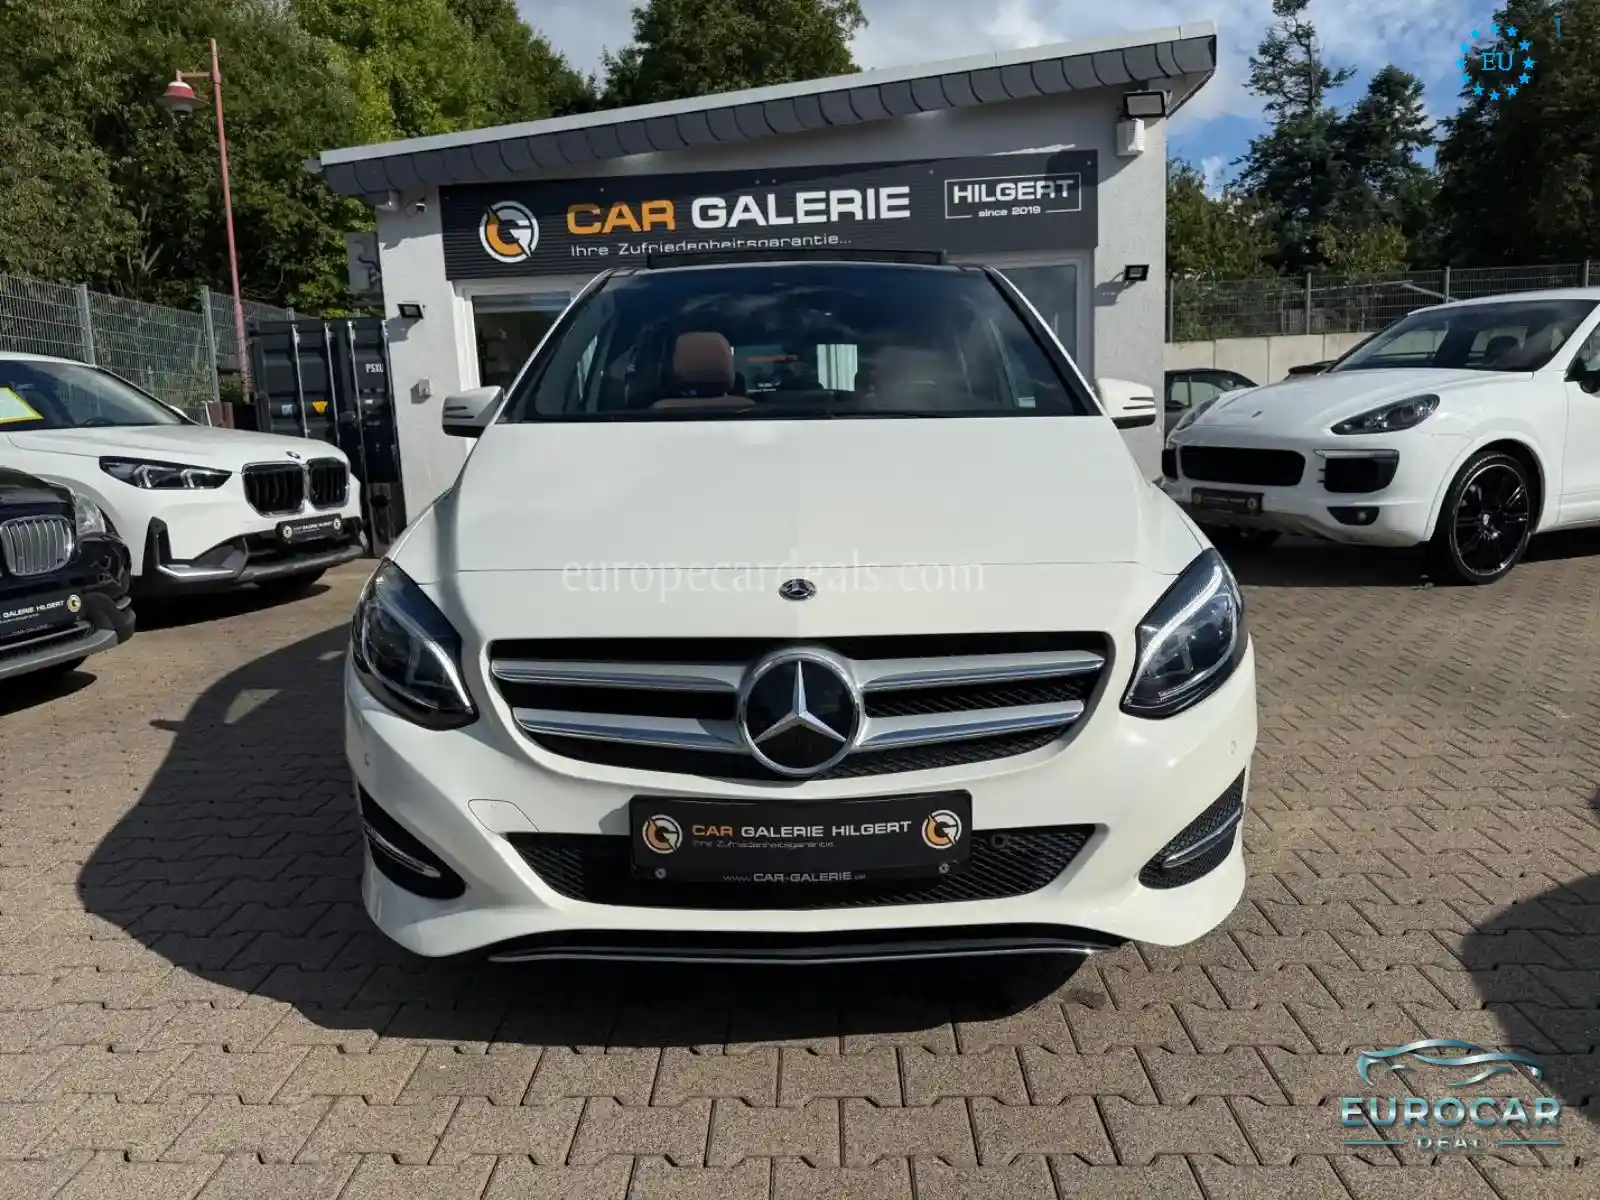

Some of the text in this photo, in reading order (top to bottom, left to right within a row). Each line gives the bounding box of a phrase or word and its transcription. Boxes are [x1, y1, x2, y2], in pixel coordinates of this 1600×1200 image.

[953, 180, 1074, 204] HILGERT
[566, 185, 910, 235] CAR GALERIE
[978, 206, 1041, 217] since 2019
[571, 245, 608, 256] Ihre
[692, 821, 912, 838] CAR GALERIE HILGERT
